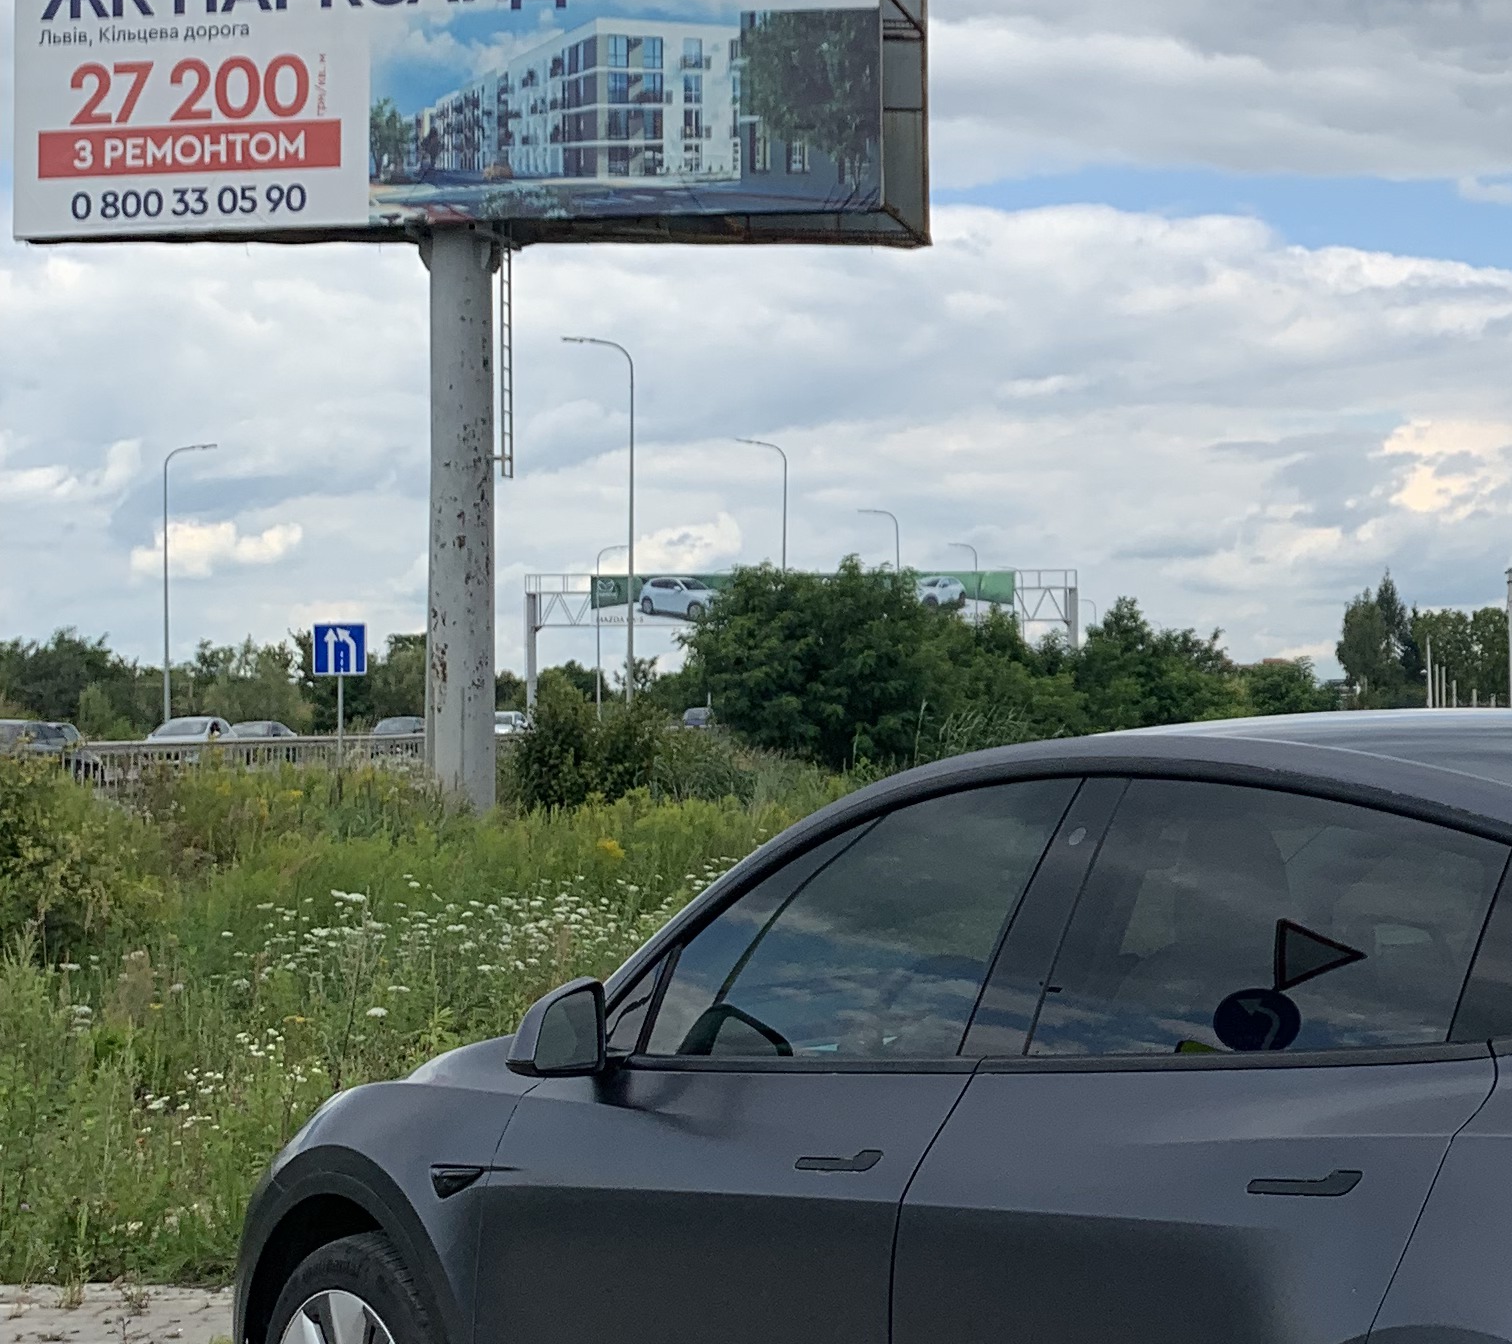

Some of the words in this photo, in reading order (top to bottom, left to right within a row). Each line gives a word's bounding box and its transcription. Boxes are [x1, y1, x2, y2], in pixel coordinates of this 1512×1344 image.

[39, 26, 93, 47] Львів,
[99, 24, 179, 44] Кільцева
[183, 22, 250, 42] дорога
[70, 60, 154, 125] 27
[169, 53, 310, 123] 200
[103, 129, 306, 168] РЕМОНТОМ
[71, 190, 92, 220] 0
[100, 188, 164, 219] 800
[171, 187, 209, 216] 33
[217, 185, 258, 214] 05
[265, 183, 307, 213] 90
